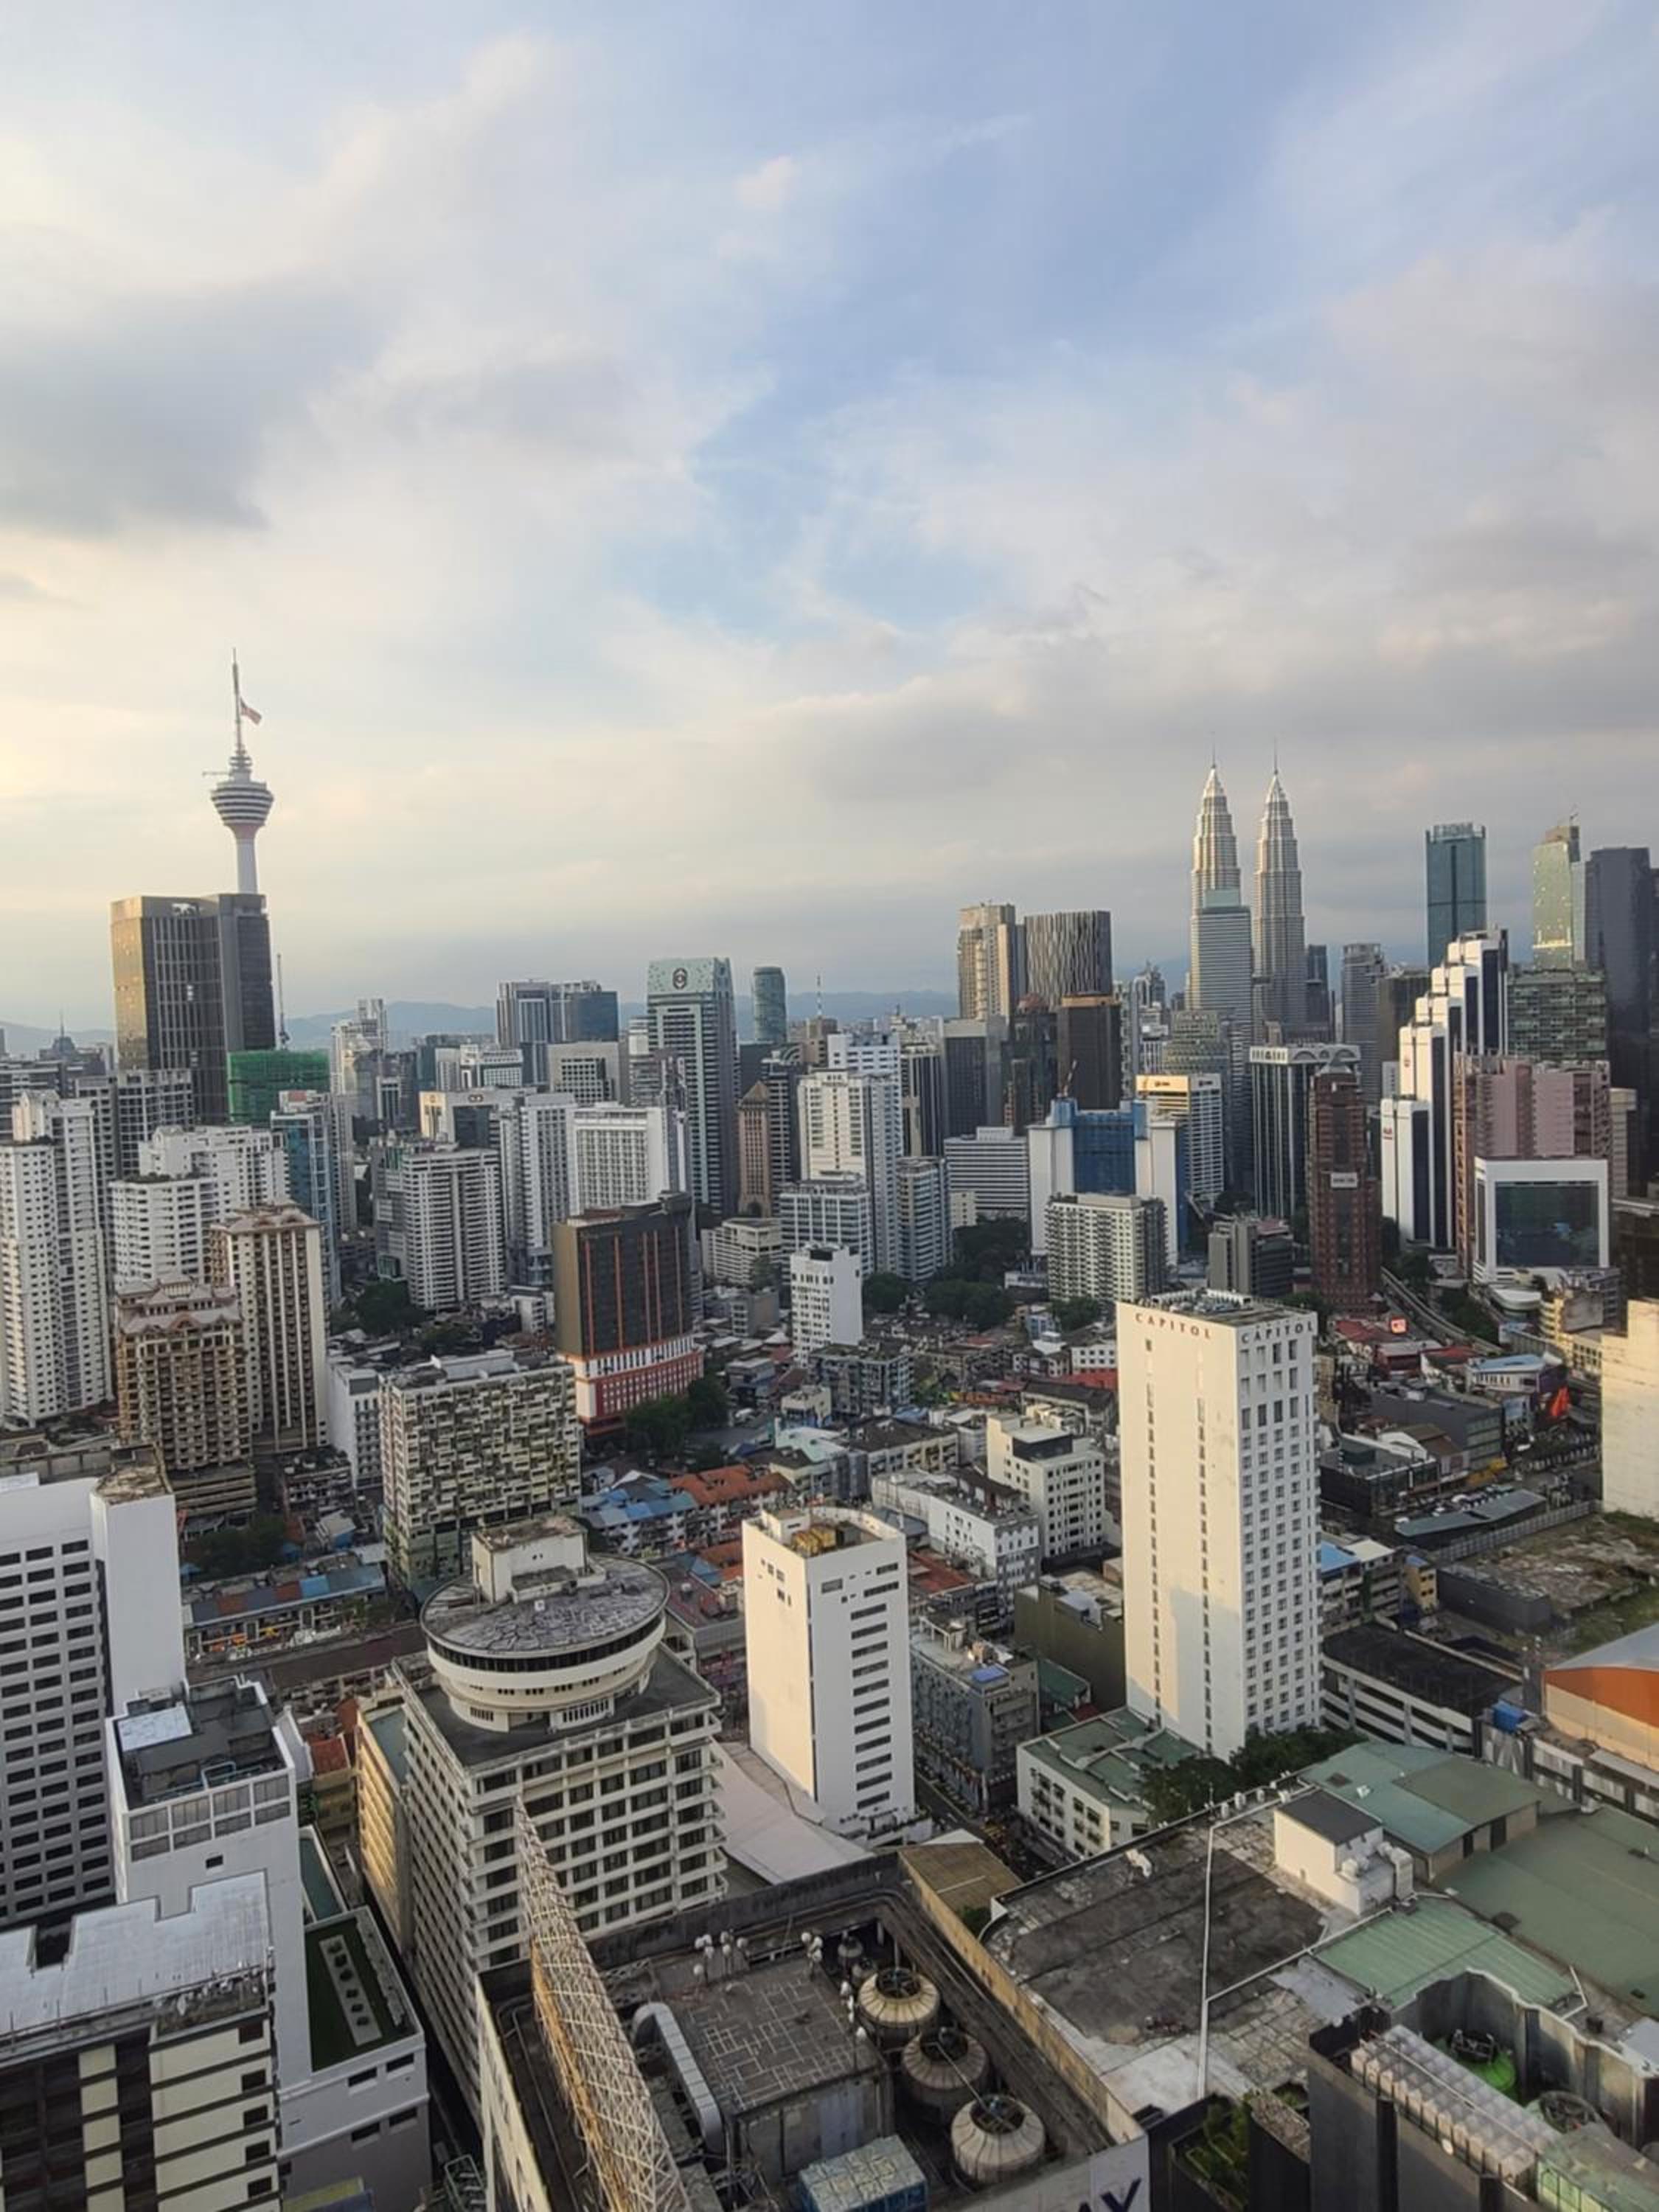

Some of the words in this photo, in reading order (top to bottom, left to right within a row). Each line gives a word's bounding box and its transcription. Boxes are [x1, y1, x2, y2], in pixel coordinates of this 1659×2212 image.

[1135, 1313, 1210, 1339] CAPITOL
[1242, 1321, 1312, 1343] CAPITOL
[1079, 2177, 1141, 2212] Y
